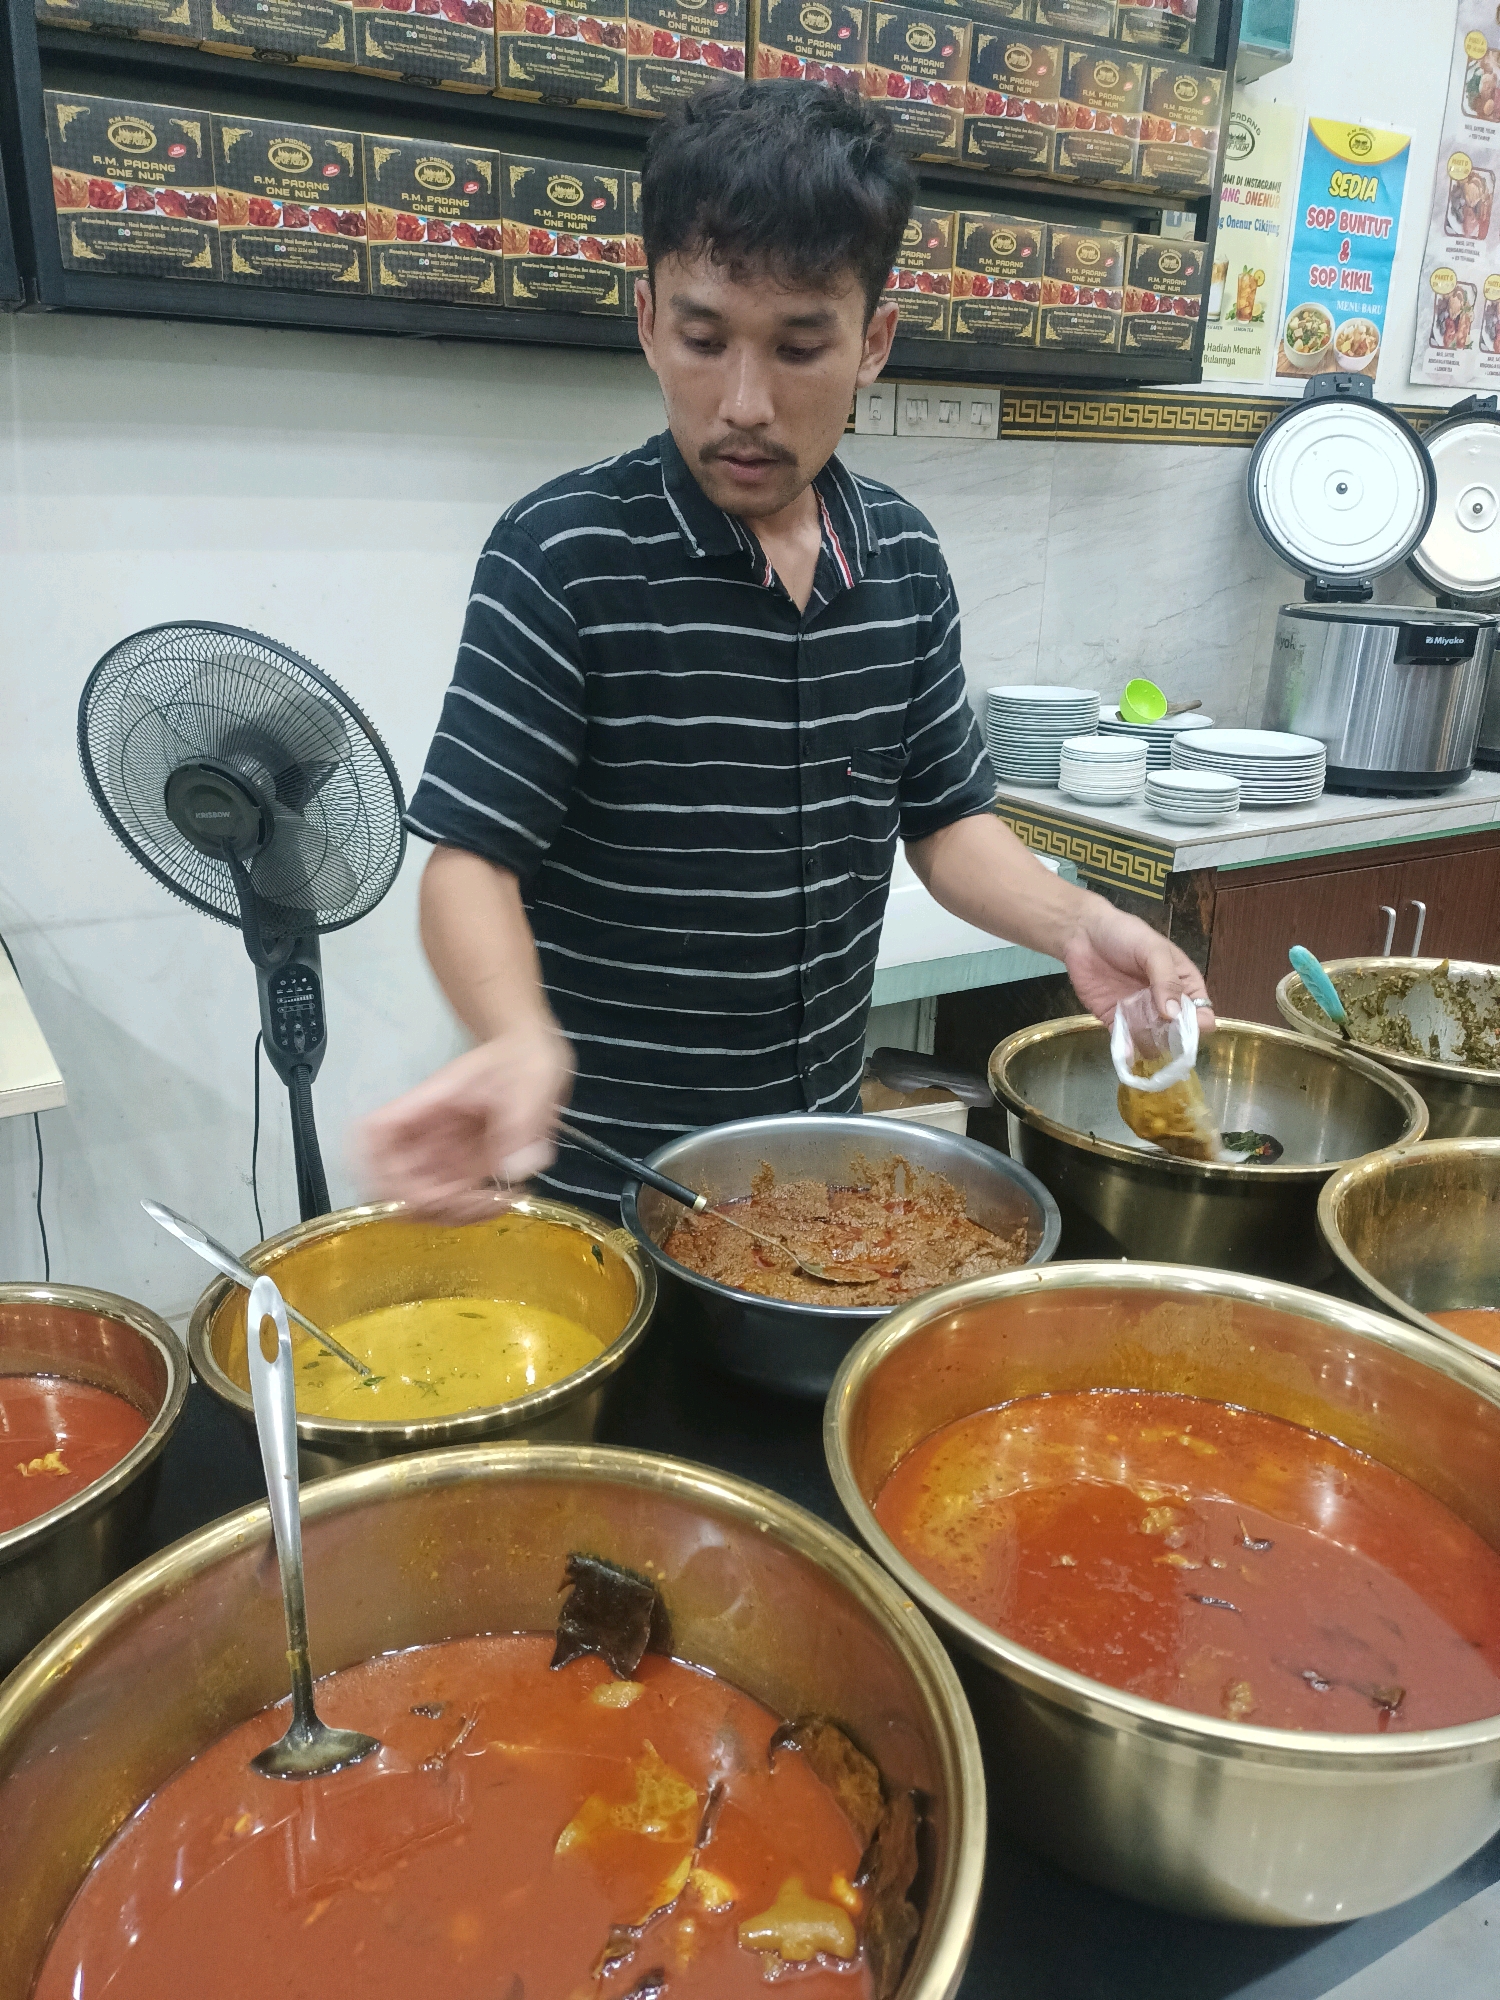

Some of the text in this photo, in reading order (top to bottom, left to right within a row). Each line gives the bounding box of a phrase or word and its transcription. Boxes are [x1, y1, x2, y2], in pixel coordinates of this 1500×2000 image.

[566, 2, 587, 10] NUR
[659, 10, 718, 27] R.M. PADANG
[668, 21, 710, 35] ONE NUR
[787, 35, 841, 51] R.M. PADANG
[795, 45, 833, 58] ONE NUR
[894, 54, 945, 68] R.M. PADANG
[901, 64, 937, 76] ONE NUR
[993, 74, 1039, 87] R.M. PADANG
[999, 83, 1032, 94] ONE NUR
[1082, 90, 1125, 102] R.M. PADANG
[1230, 112, 1261, 136] PADANG
[92, 155, 176, 172] R.M. PADANG
[107, 168, 165, 182] ONE NUR
[1223, 174, 1235, 185] AMI
[1236, 176, 1243, 186] DI
[254, 176, 329, 191] R.M. PADANG
[1328, 170, 1379, 202] SEDIA
[266, 187, 319, 199] ONE NUR
[1221, 187, 1281, 209] ANG_ONENUR
[402, 193, 470, 207] R.M. PADANG
[412, 204, 460, 216] ONE NUR
[534, 209, 596, 222] R.M. PADANG
[544, 219, 588, 230] ONE NUR
[1226, 215, 1252, 230] Onenur
[1307, 206, 1392, 238] SOP BUNTUT
[901, 250, 931, 259] PADANG
[1339, 240, 1350, 262] &
[996, 260, 1024, 268] PADANG
[1081, 269, 1107, 277] PADANG
[1310, 266, 1373, 292] SOP KIKIL
[1162, 278, 1186, 286] PADANG
[1336, 301, 1383, 315] MENU BARU
[1207, 343, 1261, 355] Hadiah Menarik
[1204, 355, 1236, 367] Bulannya
[1434, 636, 1464, 646] Miyako
